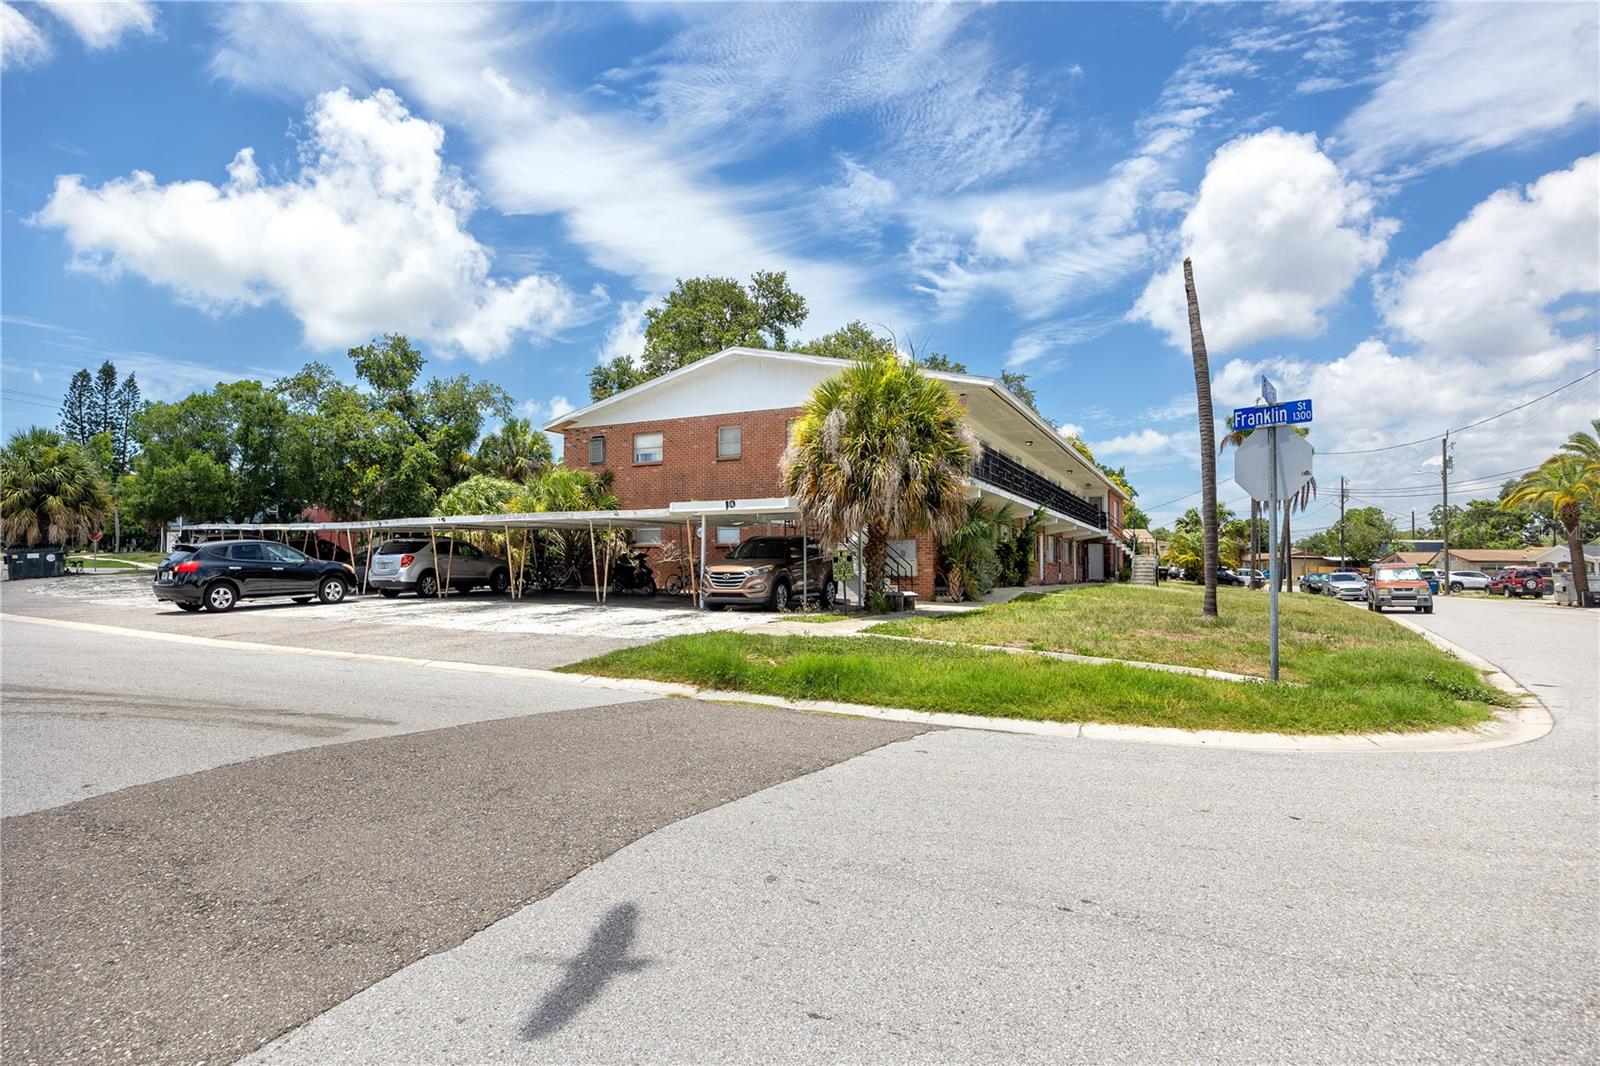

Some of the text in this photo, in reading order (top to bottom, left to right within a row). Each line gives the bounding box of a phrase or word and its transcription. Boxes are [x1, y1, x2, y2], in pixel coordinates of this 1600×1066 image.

[1234, 402, 1307, 428] Franklin St
[1293, 410, 1312, 421] 1300
[725, 500, 736, 511] 10
